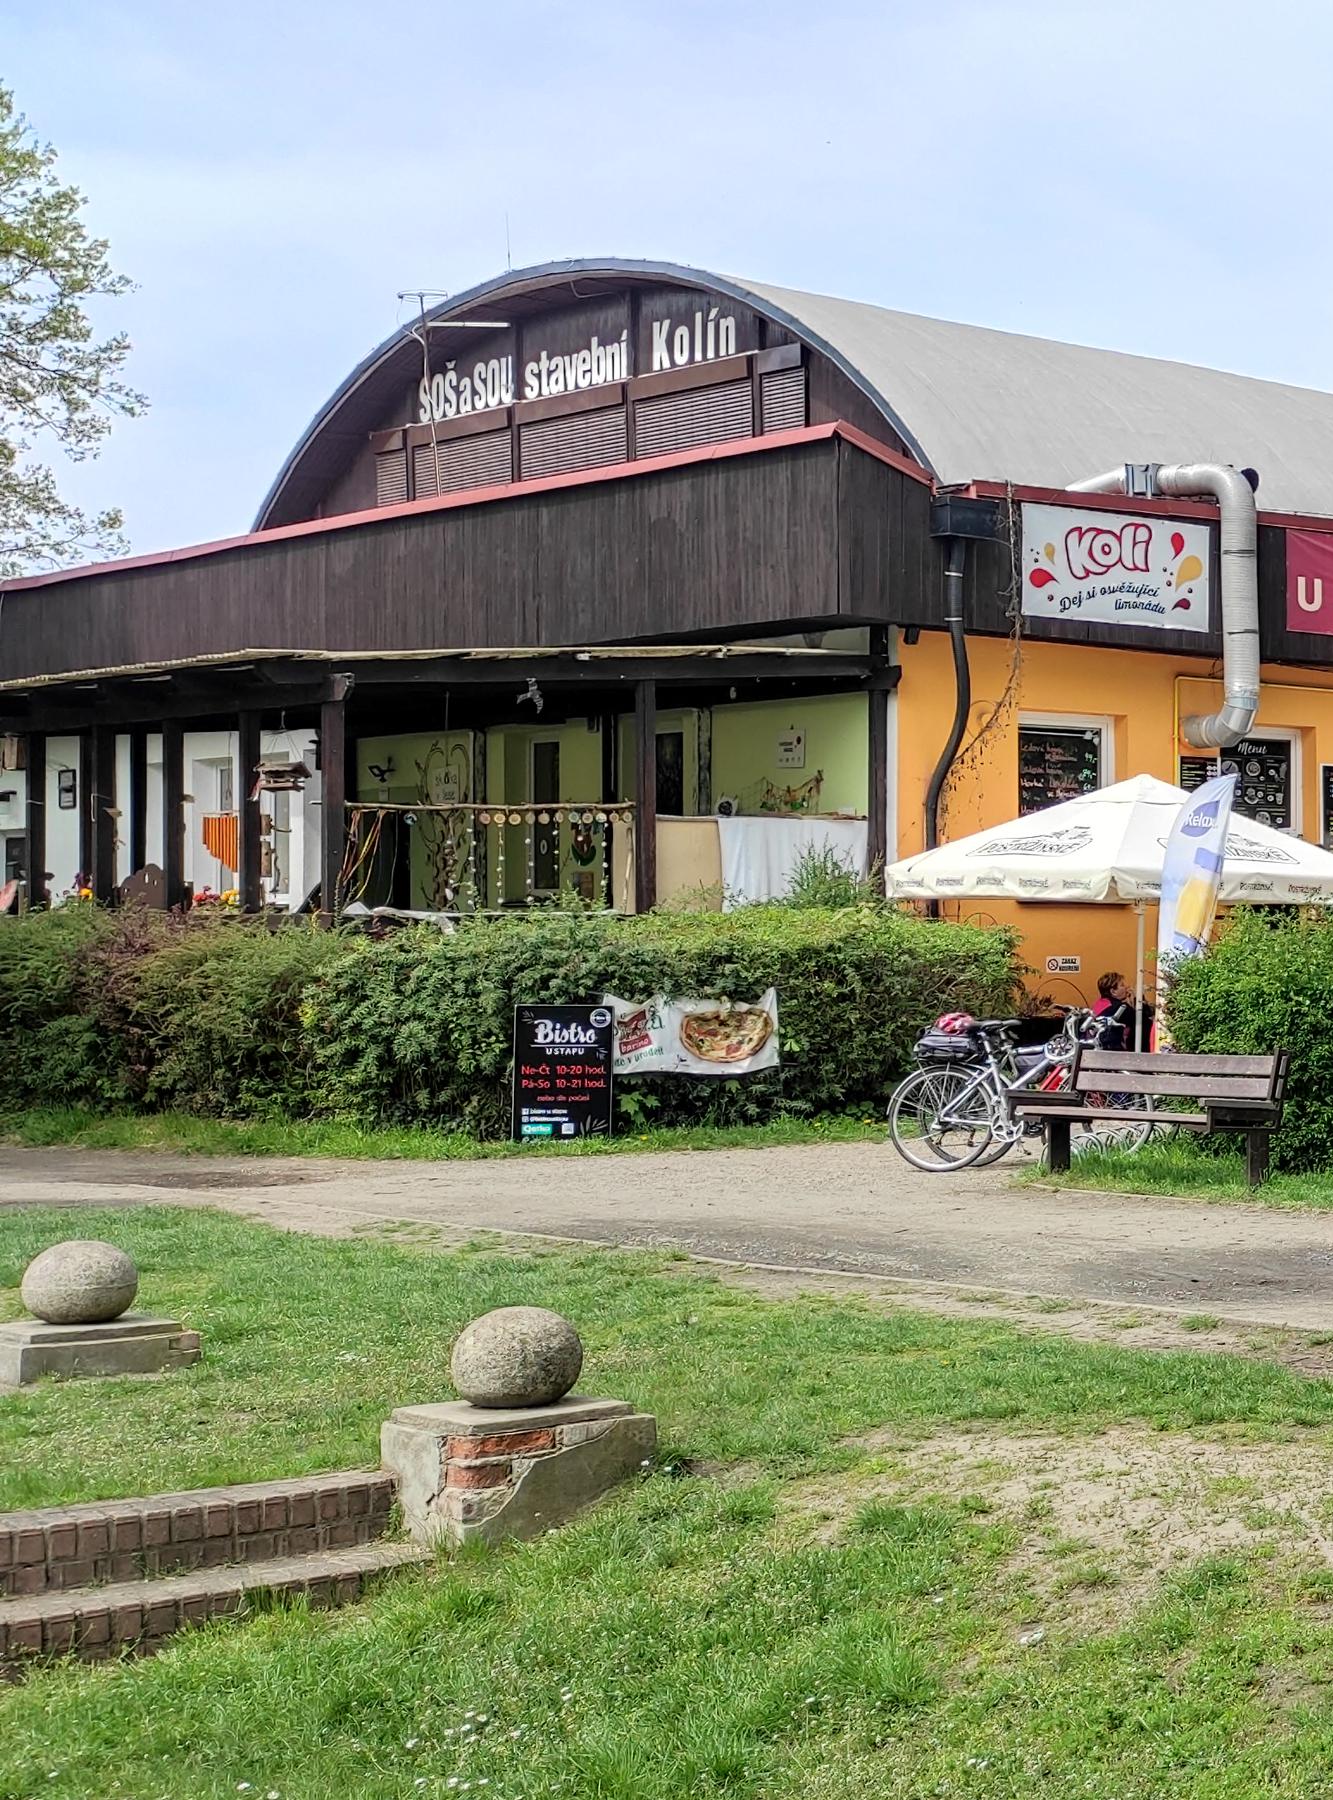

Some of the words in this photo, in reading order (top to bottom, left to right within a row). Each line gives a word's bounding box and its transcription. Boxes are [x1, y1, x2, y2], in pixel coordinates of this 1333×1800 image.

[524, 330, 628, 400] stavební
[652, 307, 737, 371] Kolín
[1059, 587, 1084, 613] Dej
[1085, 587, 1097, 601] si
[1100, 582, 1161, 599] osvěžující
[1297, 576, 1322, 612] U
[1114, 598, 1167, 615] limonádu
[1237, 742, 1268, 755] Menu
[1185, 812, 1215, 828] Relax
[533, 1019, 597, 1044] Bistro
[553, 1047, 585, 1056] STAPU
[521, 1063, 550, 1075] Ne-Čt
[556, 1065, 583, 1075] 10-20
[585, 1065, 606, 1075] hod.
[521, 1079, 550, 1089] Pá-So
[585, 1079, 606, 1088] hod.
